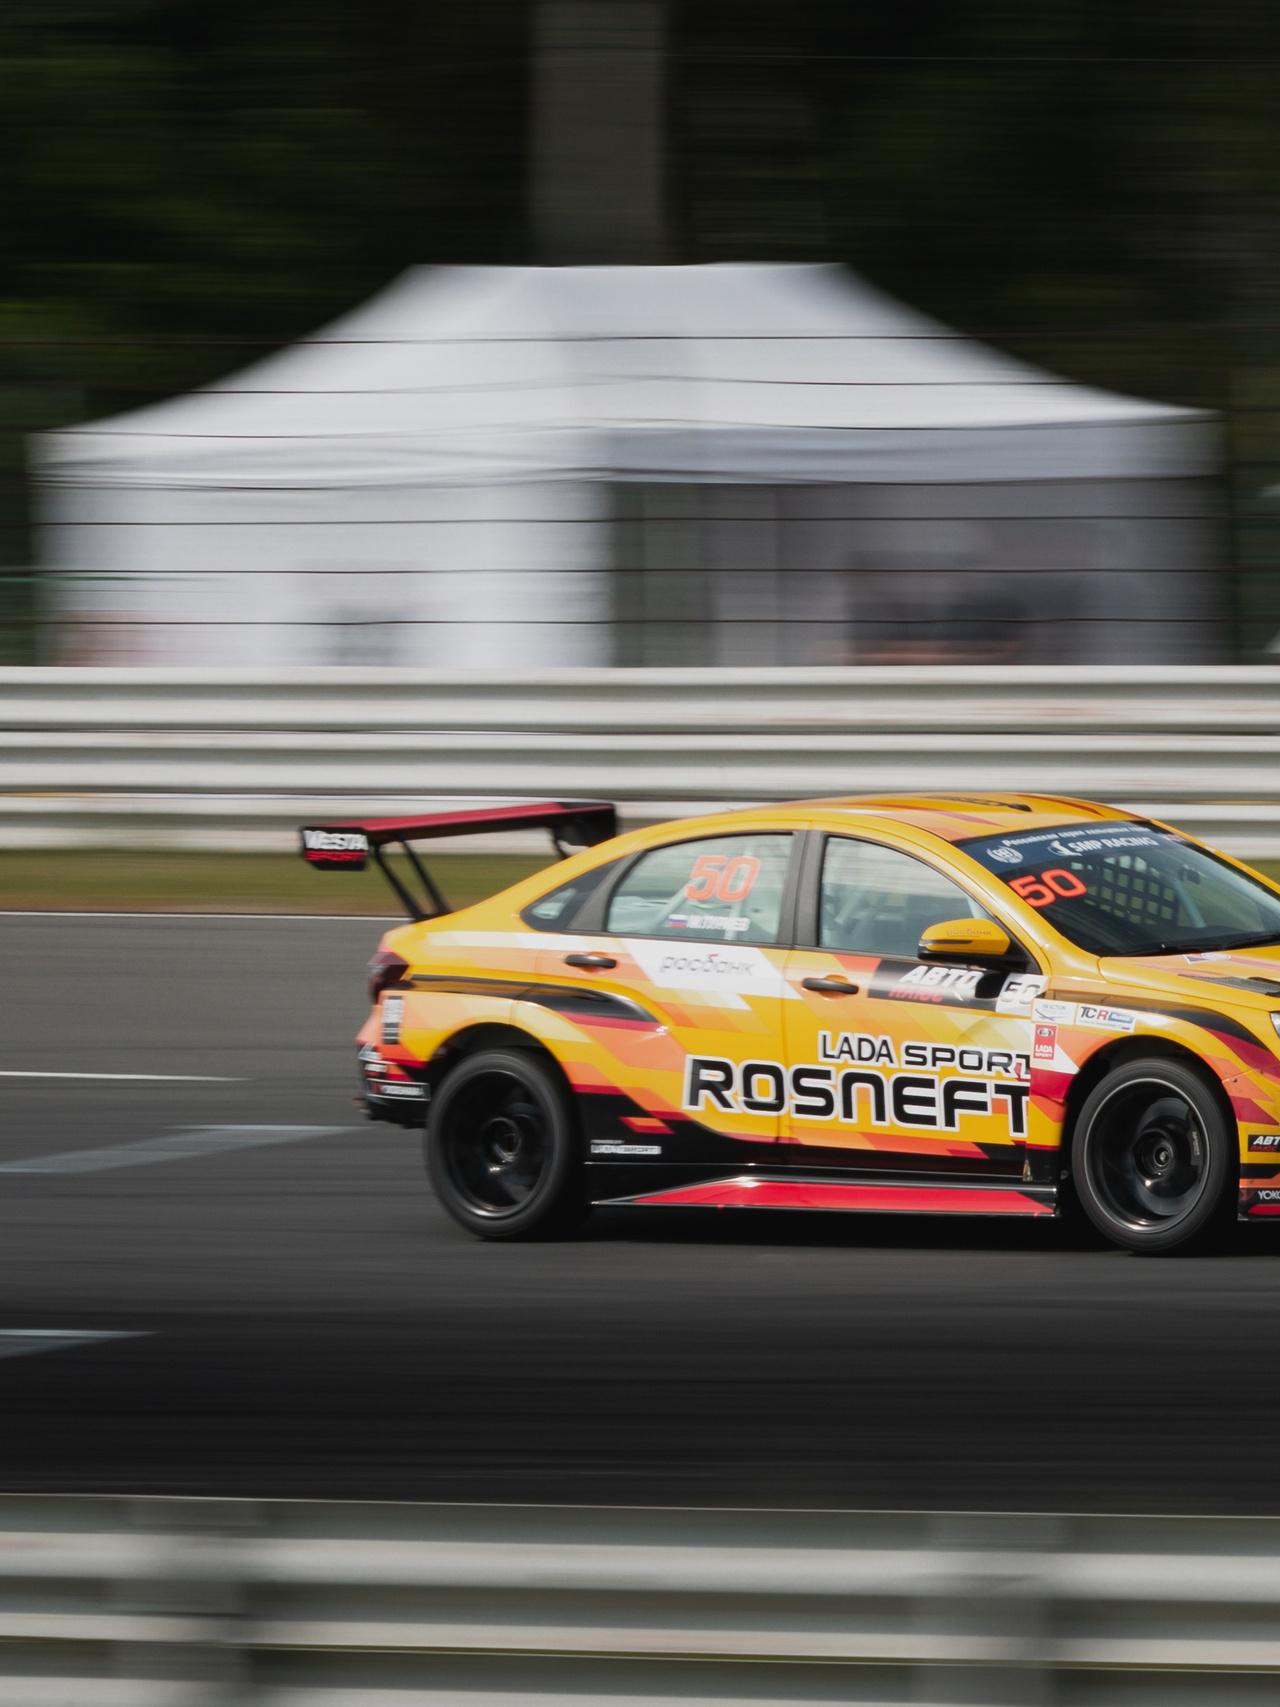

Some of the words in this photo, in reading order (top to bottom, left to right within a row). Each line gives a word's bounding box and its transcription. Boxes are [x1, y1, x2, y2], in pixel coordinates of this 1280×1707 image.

[303, 830, 369, 850] VESTA
[1068, 839, 1103, 853] SMP
[1101, 836, 1160, 849] RACING
[684, 855, 761, 901] 50
[1008, 868, 1087, 907] 50
[659, 953, 757, 977] росбанк
[1080, 1006, 1109, 1021] TCR
[820, 1032, 896, 1066] LADA
[1035, 1044, 1053, 1053] LADA
[685, 1056, 1031, 1135] ROSNEFT
